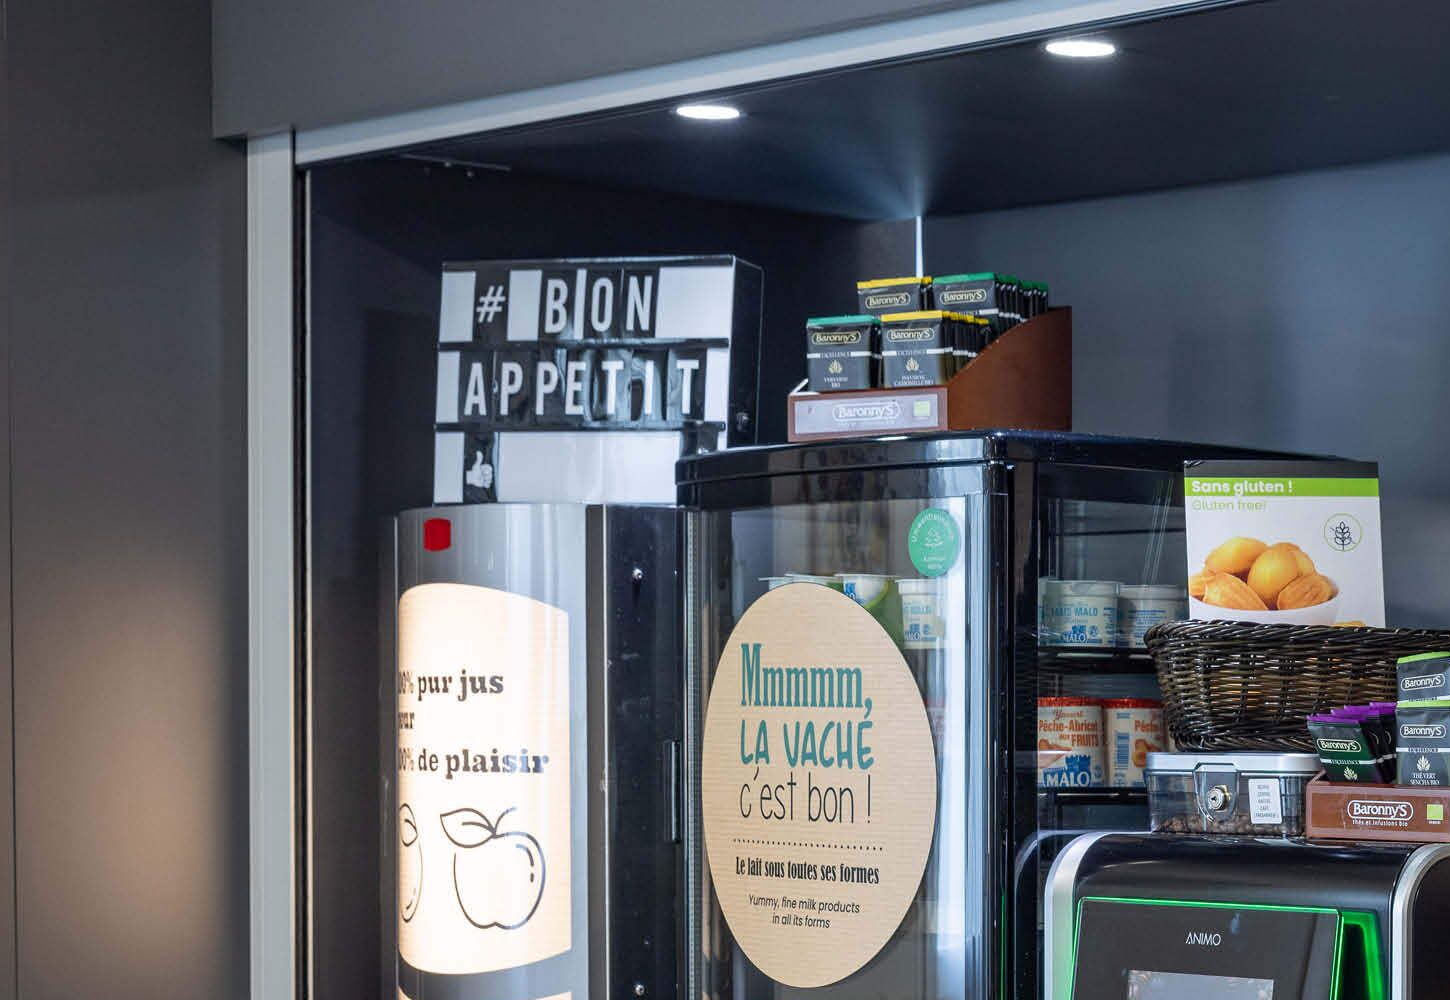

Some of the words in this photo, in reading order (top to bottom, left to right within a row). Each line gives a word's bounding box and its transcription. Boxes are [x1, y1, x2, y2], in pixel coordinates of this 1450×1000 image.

[476, 286, 506, 323] #
[544, 275, 653, 333] BON
[463, 359, 700, 416] APPETIT
[1191, 480, 1230, 493] Sans
[1233, 480, 1284, 495] gluten
[1288, 480, 1293, 493] !
[417, 675, 453, 702] pur
[457, 668, 504, 702] jus
[740, 643, 873, 719] Mmmmm,
[740, 719, 770, 765] LA
[783, 720, 874, 770] VACHE
[418, 748, 439, 771] de
[445, 748, 550, 780] plaisir
[1046, 772, 1090, 787] MALO
[740, 766, 797, 821] c'est
[808, 771, 855, 824] bon
[866, 774, 872, 824] !
[736, 856, 746, 875] Le
[747, 857, 762, 876] lait
[764, 862, 785, 878] sous
[787, 861, 818, 881] toutes
[820, 865, 837, 882] ses
[839, 863, 880, 884] formes
[748, 895, 780, 911] Yummy,
[781, 896, 797, 908] fine
[799, 899, 817, 910] milk
[817, 900, 860, 914] products
[772, 914, 780, 924] in
[782, 915, 791, 925] all
[793, 915, 803, 926] its
[804, 915, 830, 928] forms
[1185, 932, 1222, 946] ANIMO
